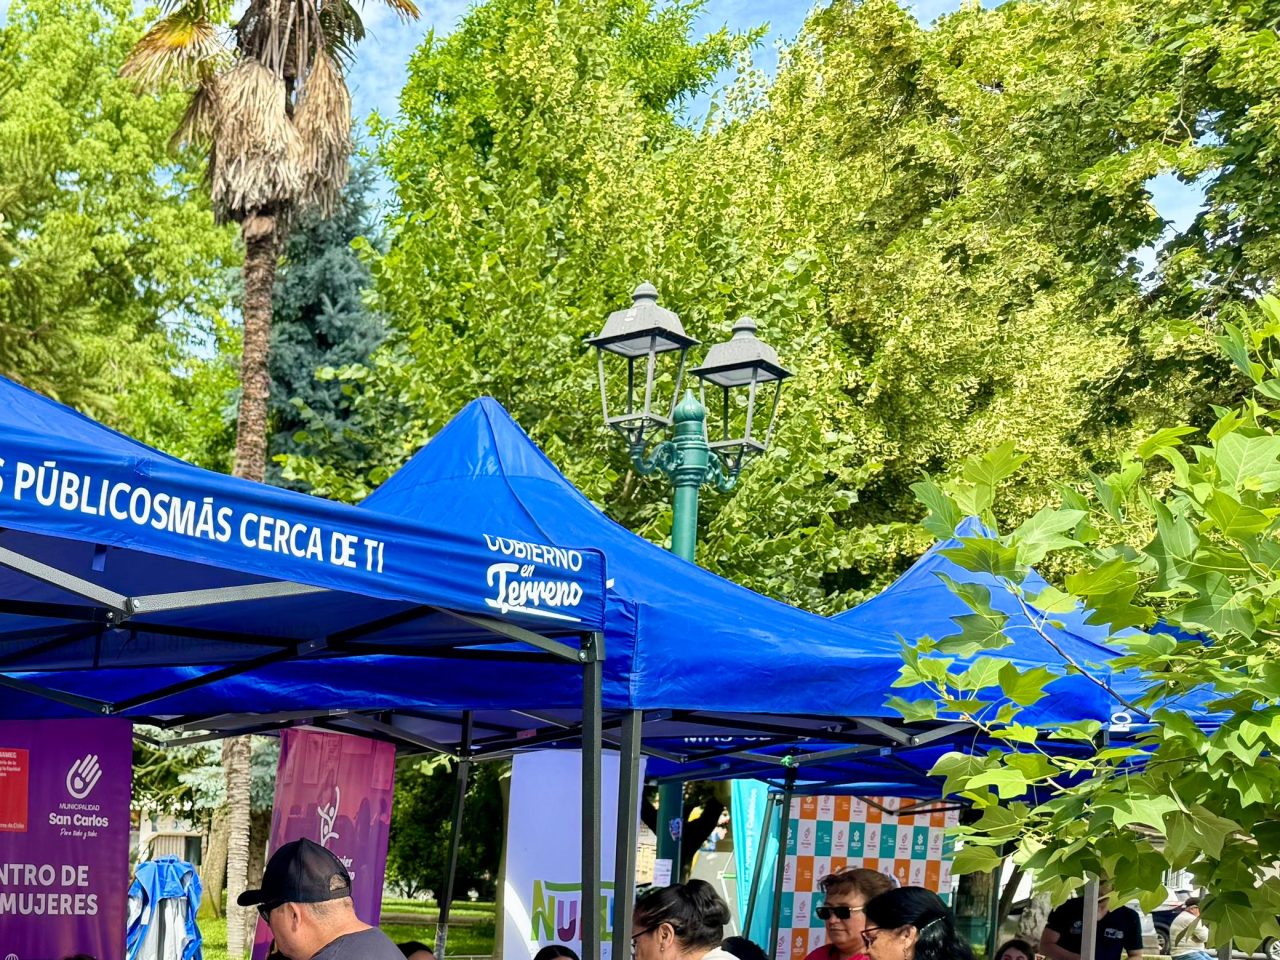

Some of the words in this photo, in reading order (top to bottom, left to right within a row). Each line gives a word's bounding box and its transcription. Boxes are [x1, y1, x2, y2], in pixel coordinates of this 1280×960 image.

[239, 512, 322, 561] CERCA
[330, 531, 358, 568] DE
[363, 538, 385, 574] TI
[520, 564, 536, 578] en
[486, 562, 584, 615] Terreno
[59, 803, 100, 811] MUNICIPALIDAD
[49, 812, 71, 825] San
[73, 814, 109, 827] Carlos
[61, 865, 89, 886] DE
